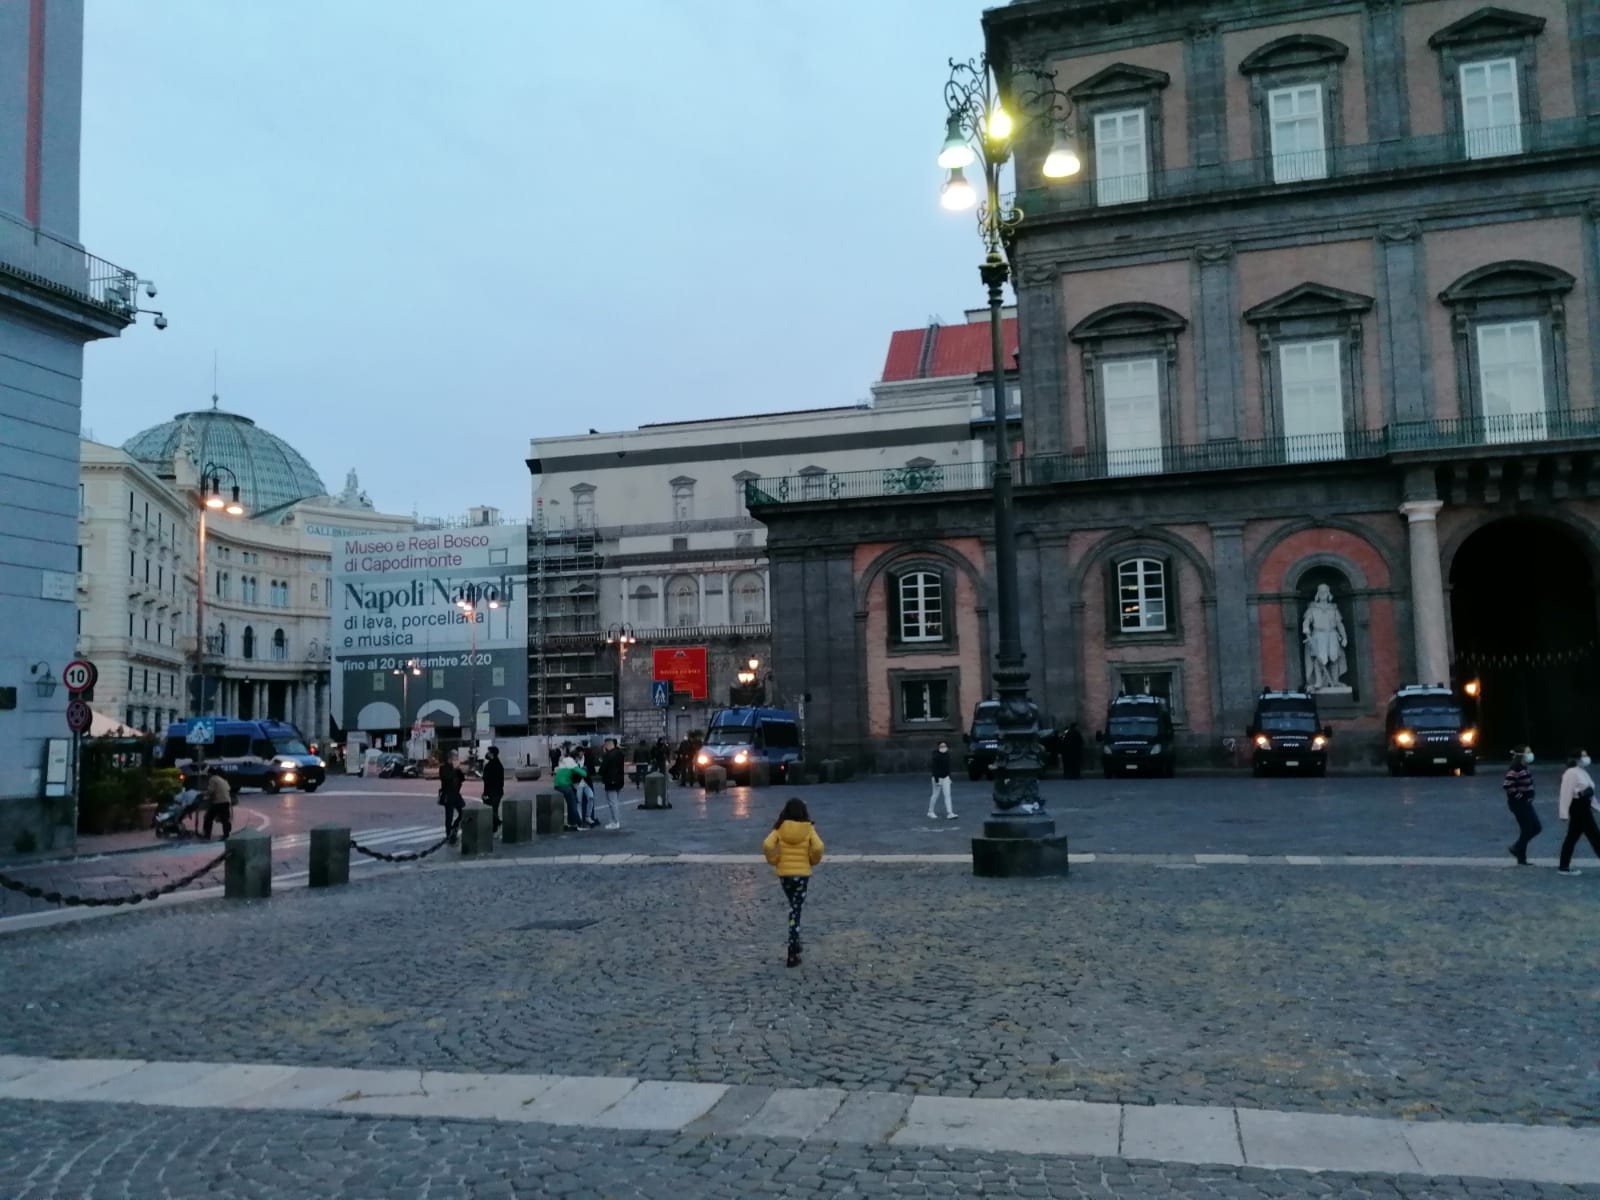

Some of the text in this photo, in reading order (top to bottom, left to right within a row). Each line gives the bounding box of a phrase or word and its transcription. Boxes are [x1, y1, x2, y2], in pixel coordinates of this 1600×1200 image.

[345, 534, 489, 555] Museo e Real Bosco
[344, 553, 463, 574] di Capodimonte
[344, 573, 514, 613] Napoli Napoli
[344, 616, 358, 630] di
[362, 615, 397, 631] lava,
[343, 631, 414, 648] e musica
[343, 661, 366, 671] fino
[367, 659, 378, 670] al
[380, 658, 396, 670] 20
[398, 655, 459, 670] stembre
[69, 670, 85, 683] 10
